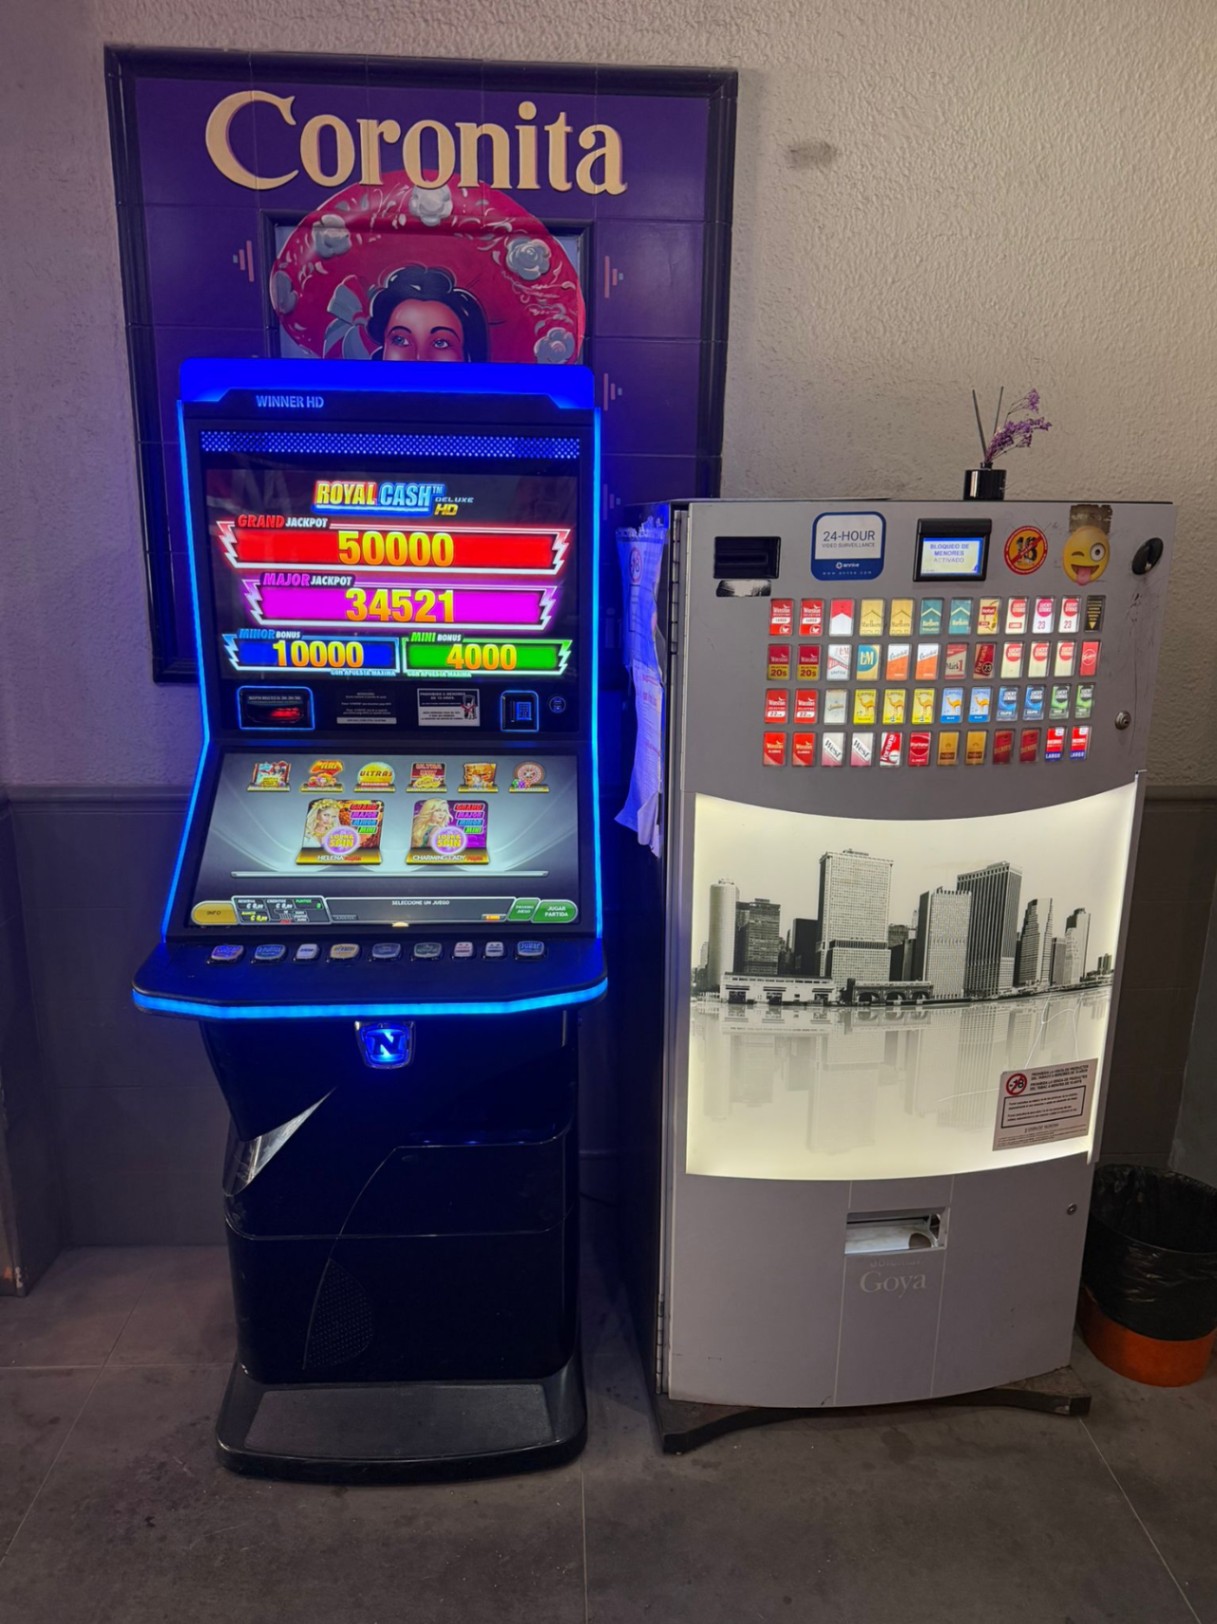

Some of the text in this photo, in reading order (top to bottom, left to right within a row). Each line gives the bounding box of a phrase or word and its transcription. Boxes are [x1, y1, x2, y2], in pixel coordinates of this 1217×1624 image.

[204, 90, 628, 195] Coronita
[256, 395, 325, 408] WINNER HD
[315, 482, 376, 505] ROYAL
[434, 503, 459, 516] HD
[238, 515, 328, 528] GRAND JACKPOT
[823, 530, 876, 542] 24-HOUR
[338, 530, 455, 567] 50000
[263, 573, 353, 587] MAJOR JACKPOT
[345, 588, 455, 623] 34521
[239, 629, 301, 639] MINOR BONUS
[410, 632, 462, 642] MINI BONUS
[273, 640, 365, 668] 10000
[446, 643, 518, 671] 4000
[860, 1270, 927, 1298] Goya
